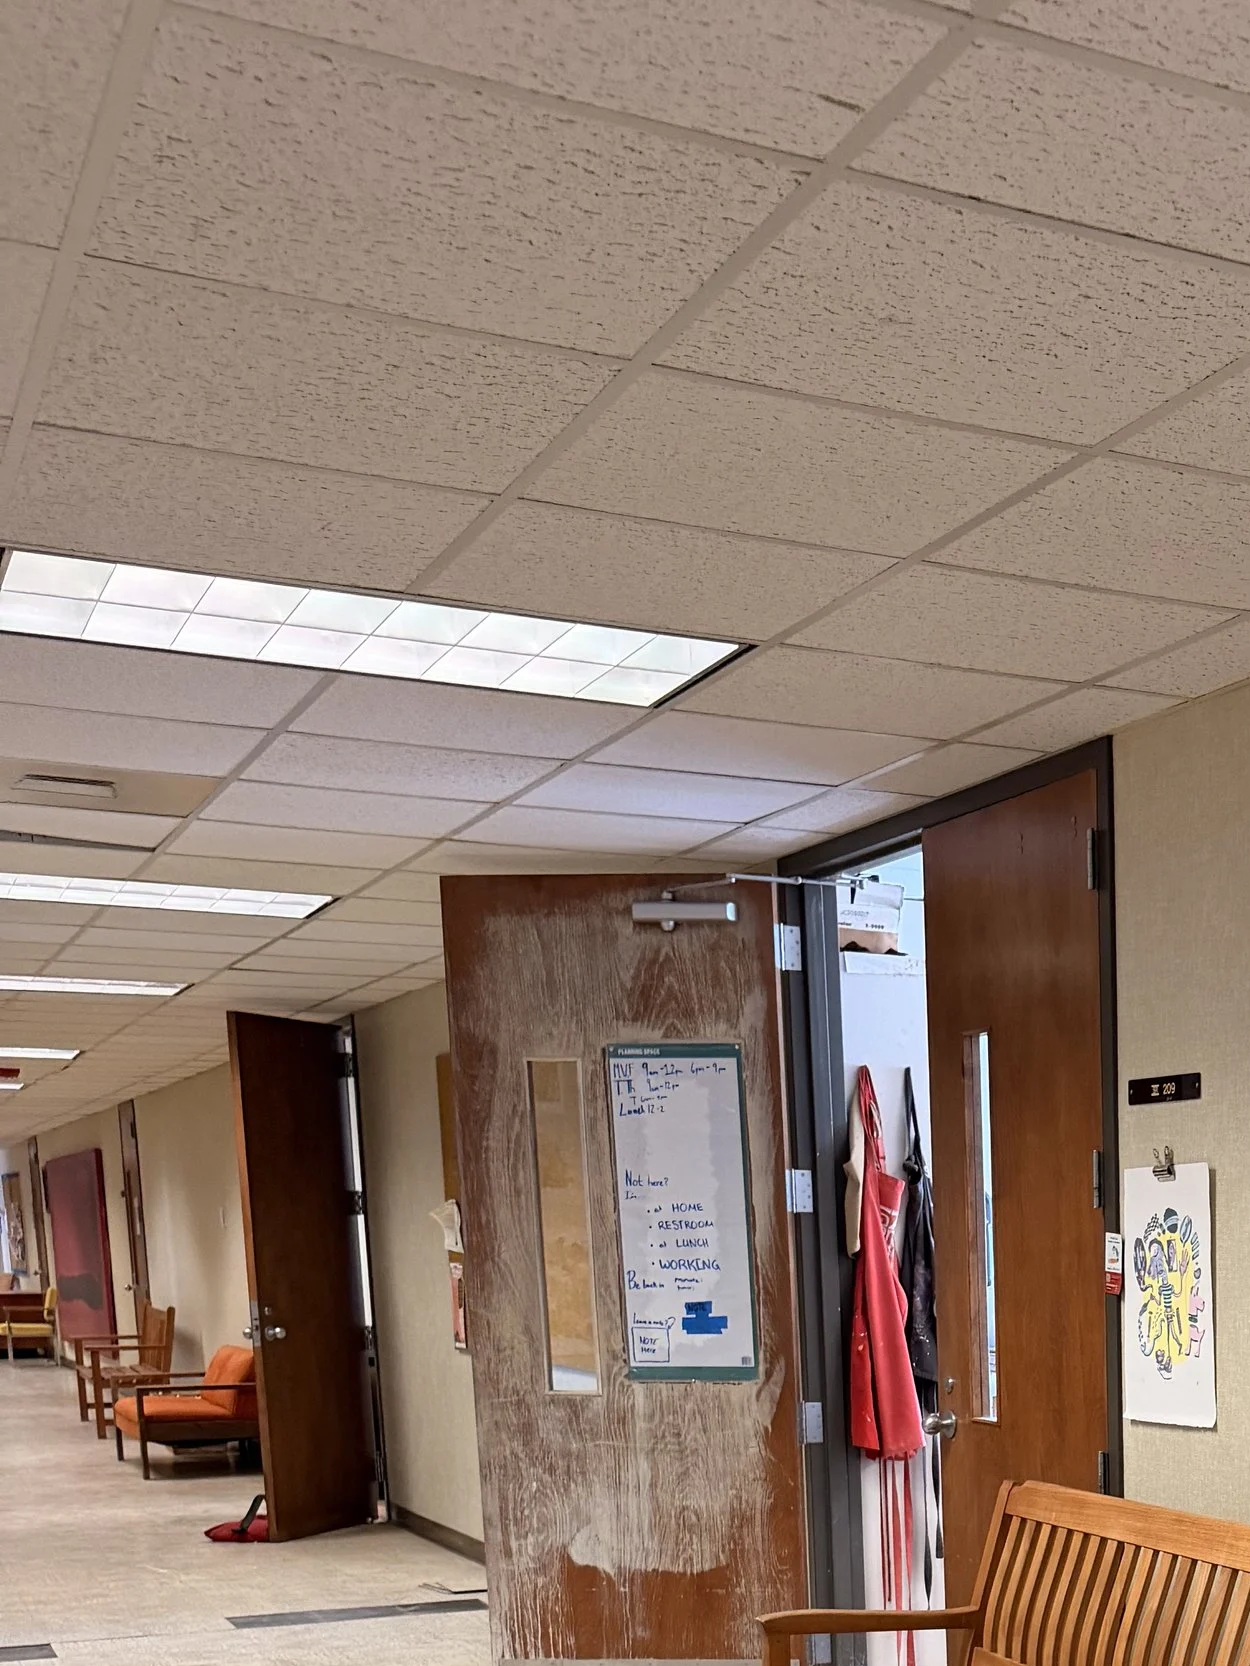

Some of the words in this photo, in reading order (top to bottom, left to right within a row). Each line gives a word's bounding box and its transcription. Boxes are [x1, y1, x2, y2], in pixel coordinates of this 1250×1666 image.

[1163, 1082, 1176, 1095] 209
[625, 1169, 643, 1187] Not
[647, 1174, 669, 1187] here?
[672, 1203, 704, 1213] HOME
[658, 1220, 714, 1231] RESTROOM
[676, 1238, 709, 1248] LUNCH
[659, 1259, 720, 1271] WORKING
[627, 1270, 640, 1290] Be
